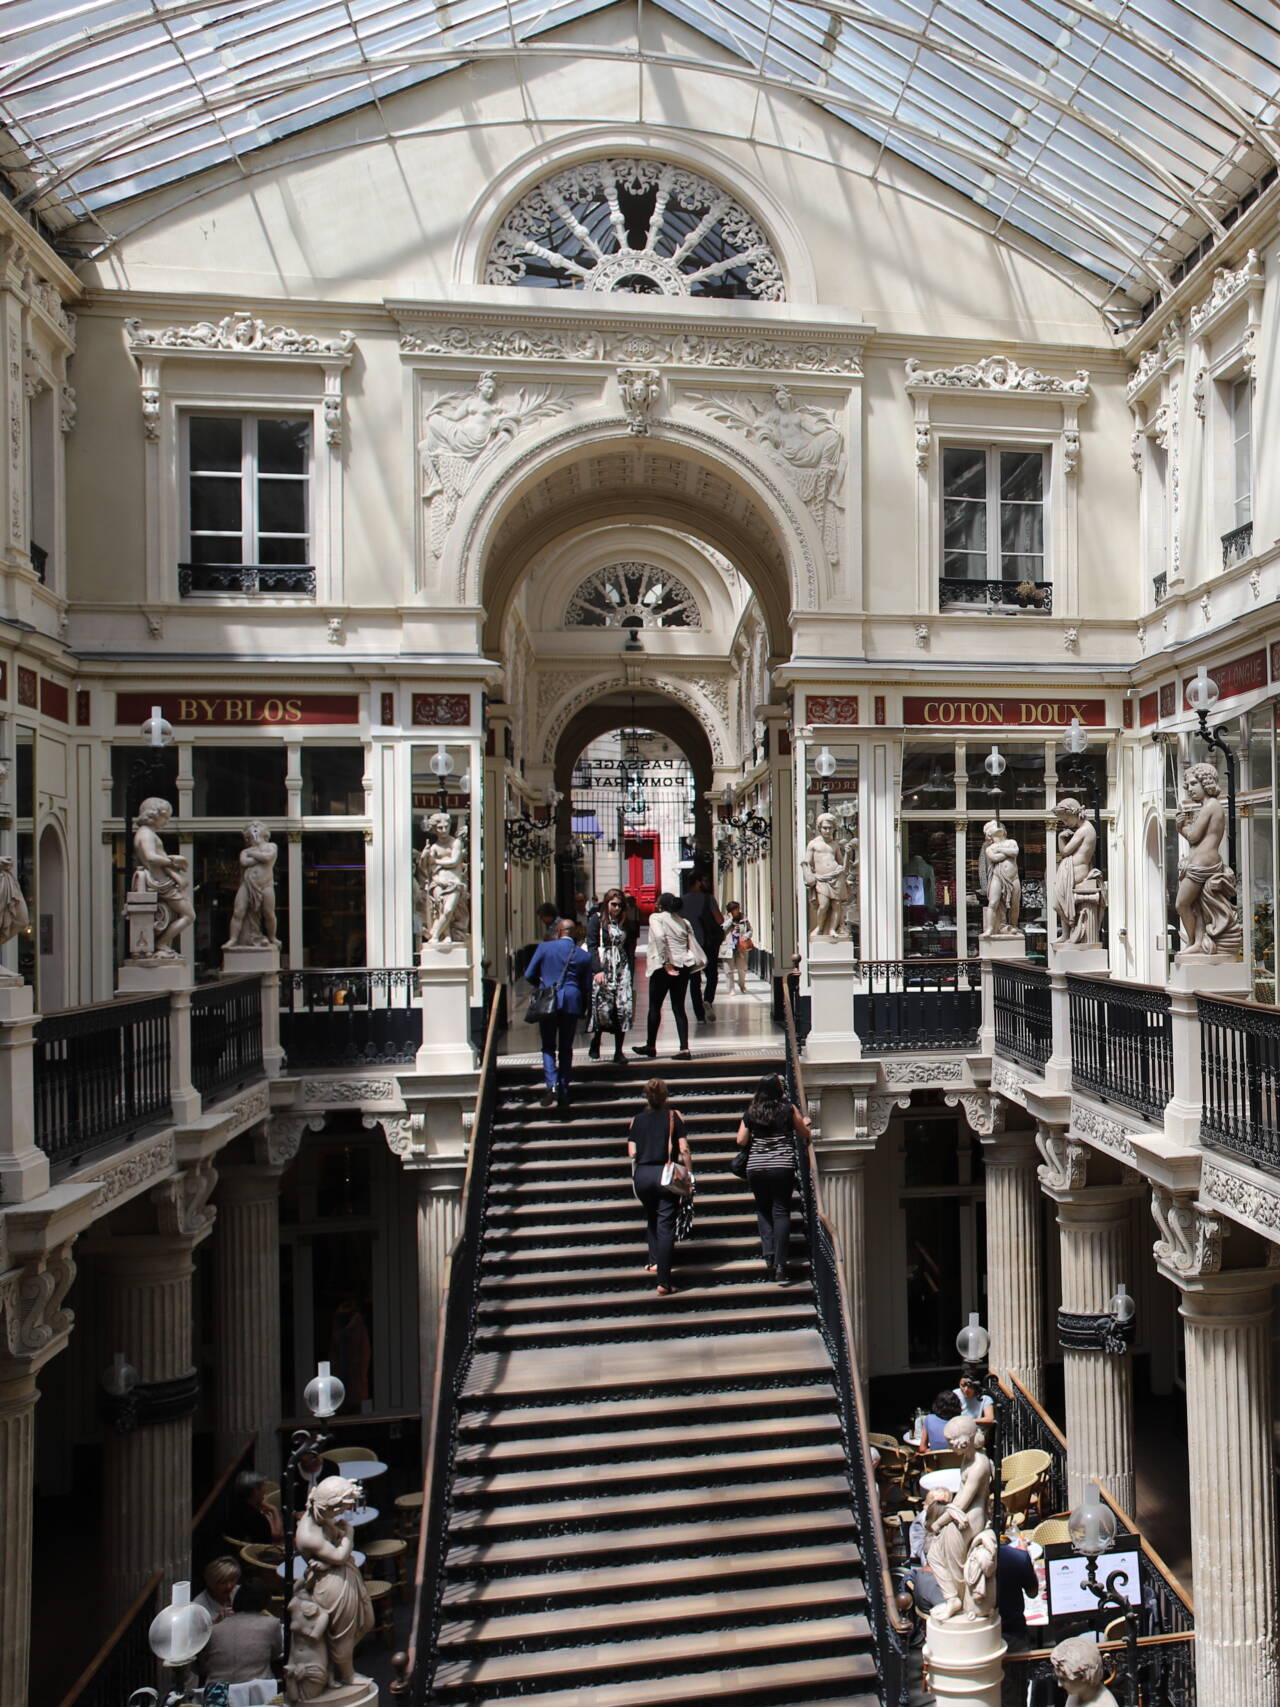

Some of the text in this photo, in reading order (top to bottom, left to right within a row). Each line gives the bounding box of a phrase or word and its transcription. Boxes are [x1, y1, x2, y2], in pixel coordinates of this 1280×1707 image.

[179, 699, 302, 721] BYBLOS
[923, 702, 1088, 725] COTON DOUX
